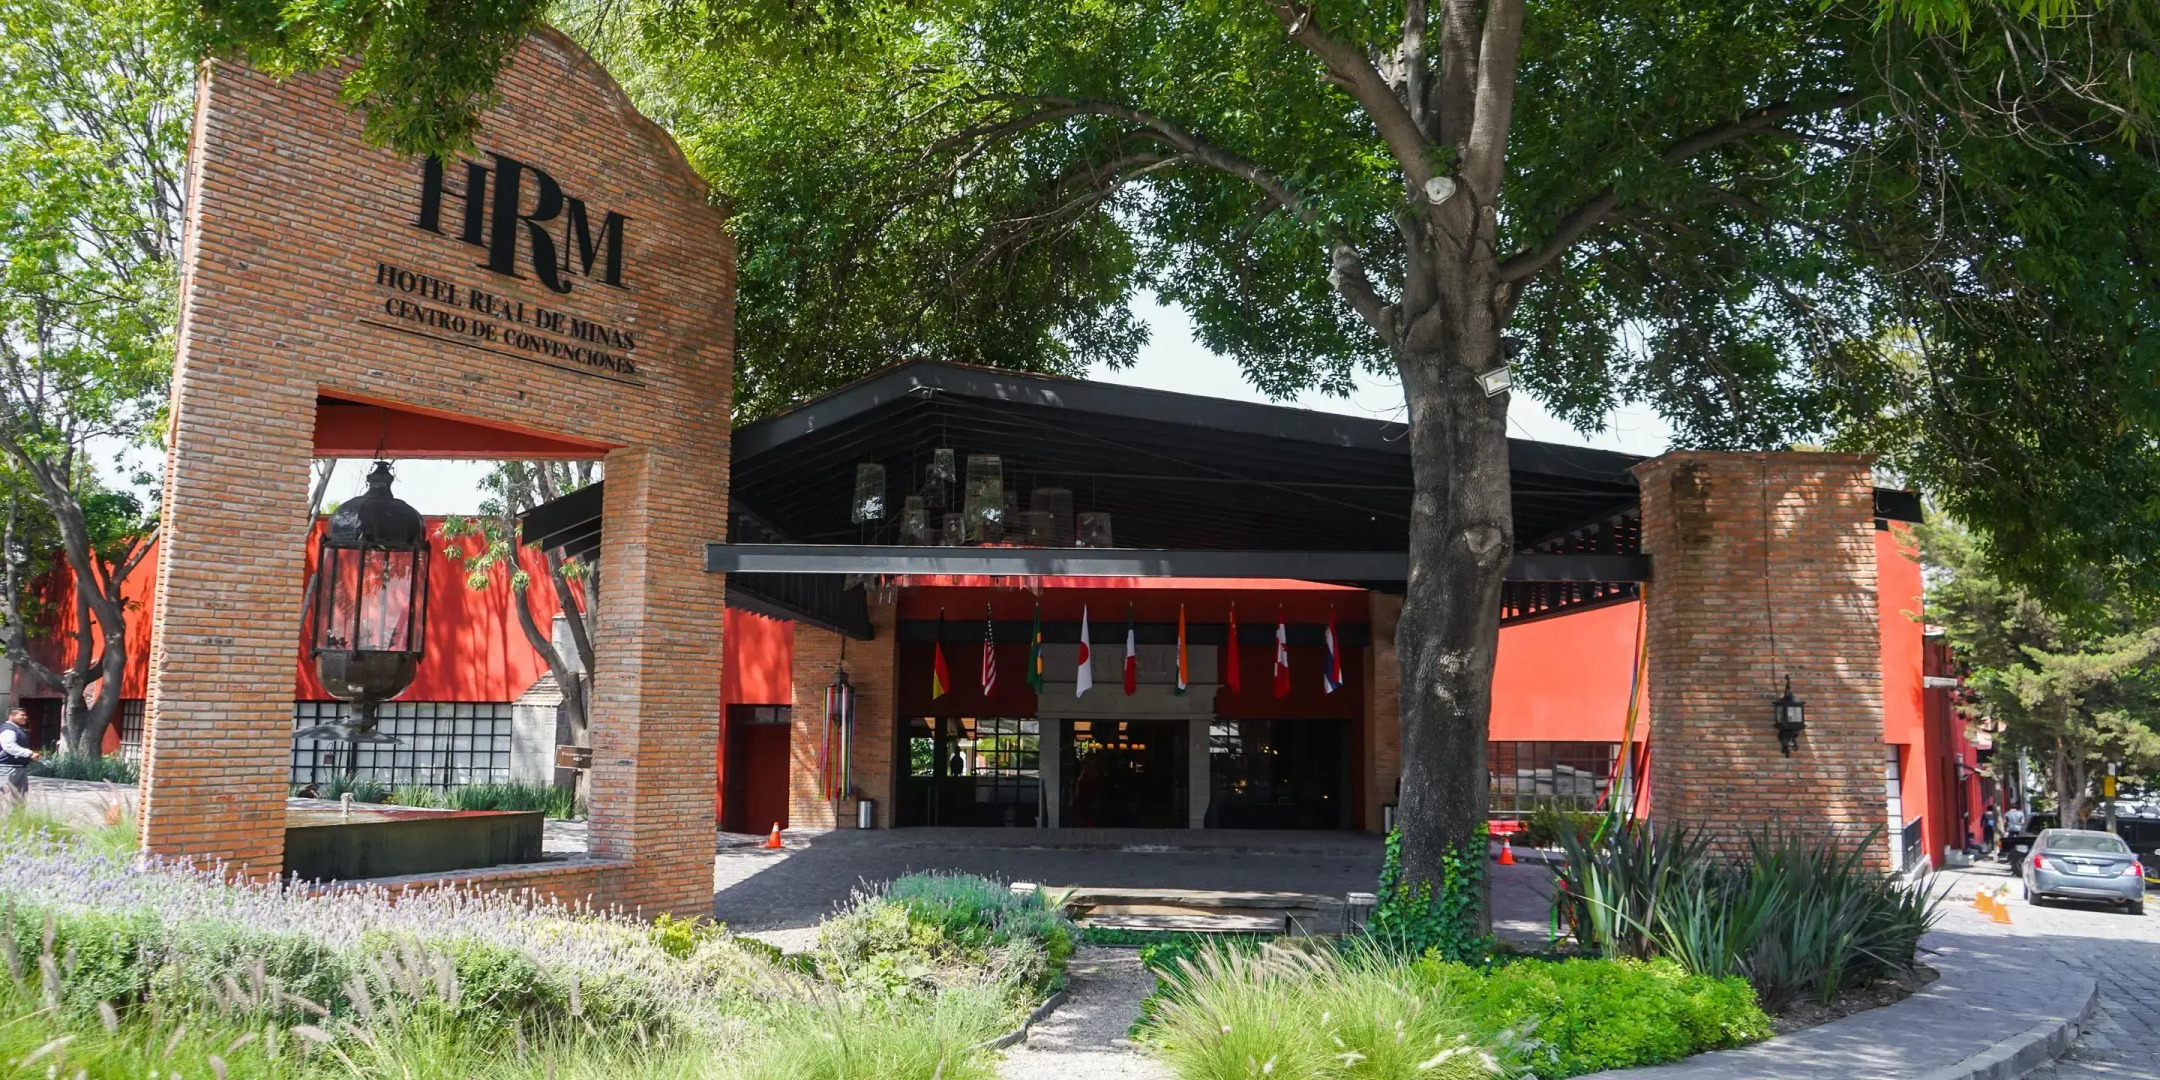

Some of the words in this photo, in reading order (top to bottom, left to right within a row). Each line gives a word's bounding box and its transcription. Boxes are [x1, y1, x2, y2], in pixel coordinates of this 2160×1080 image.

[409, 151, 633, 294] HRM
[376, 262, 461, 306] HOTEL
[469, 289, 529, 324] REAL
[536, 308, 565, 333] DE
[571, 318, 635, 350] MINAS
[385, 298, 466, 333] CENTRO
[471, 319, 497, 341] DE
[504, 328, 635, 373] CONVENCIONES
